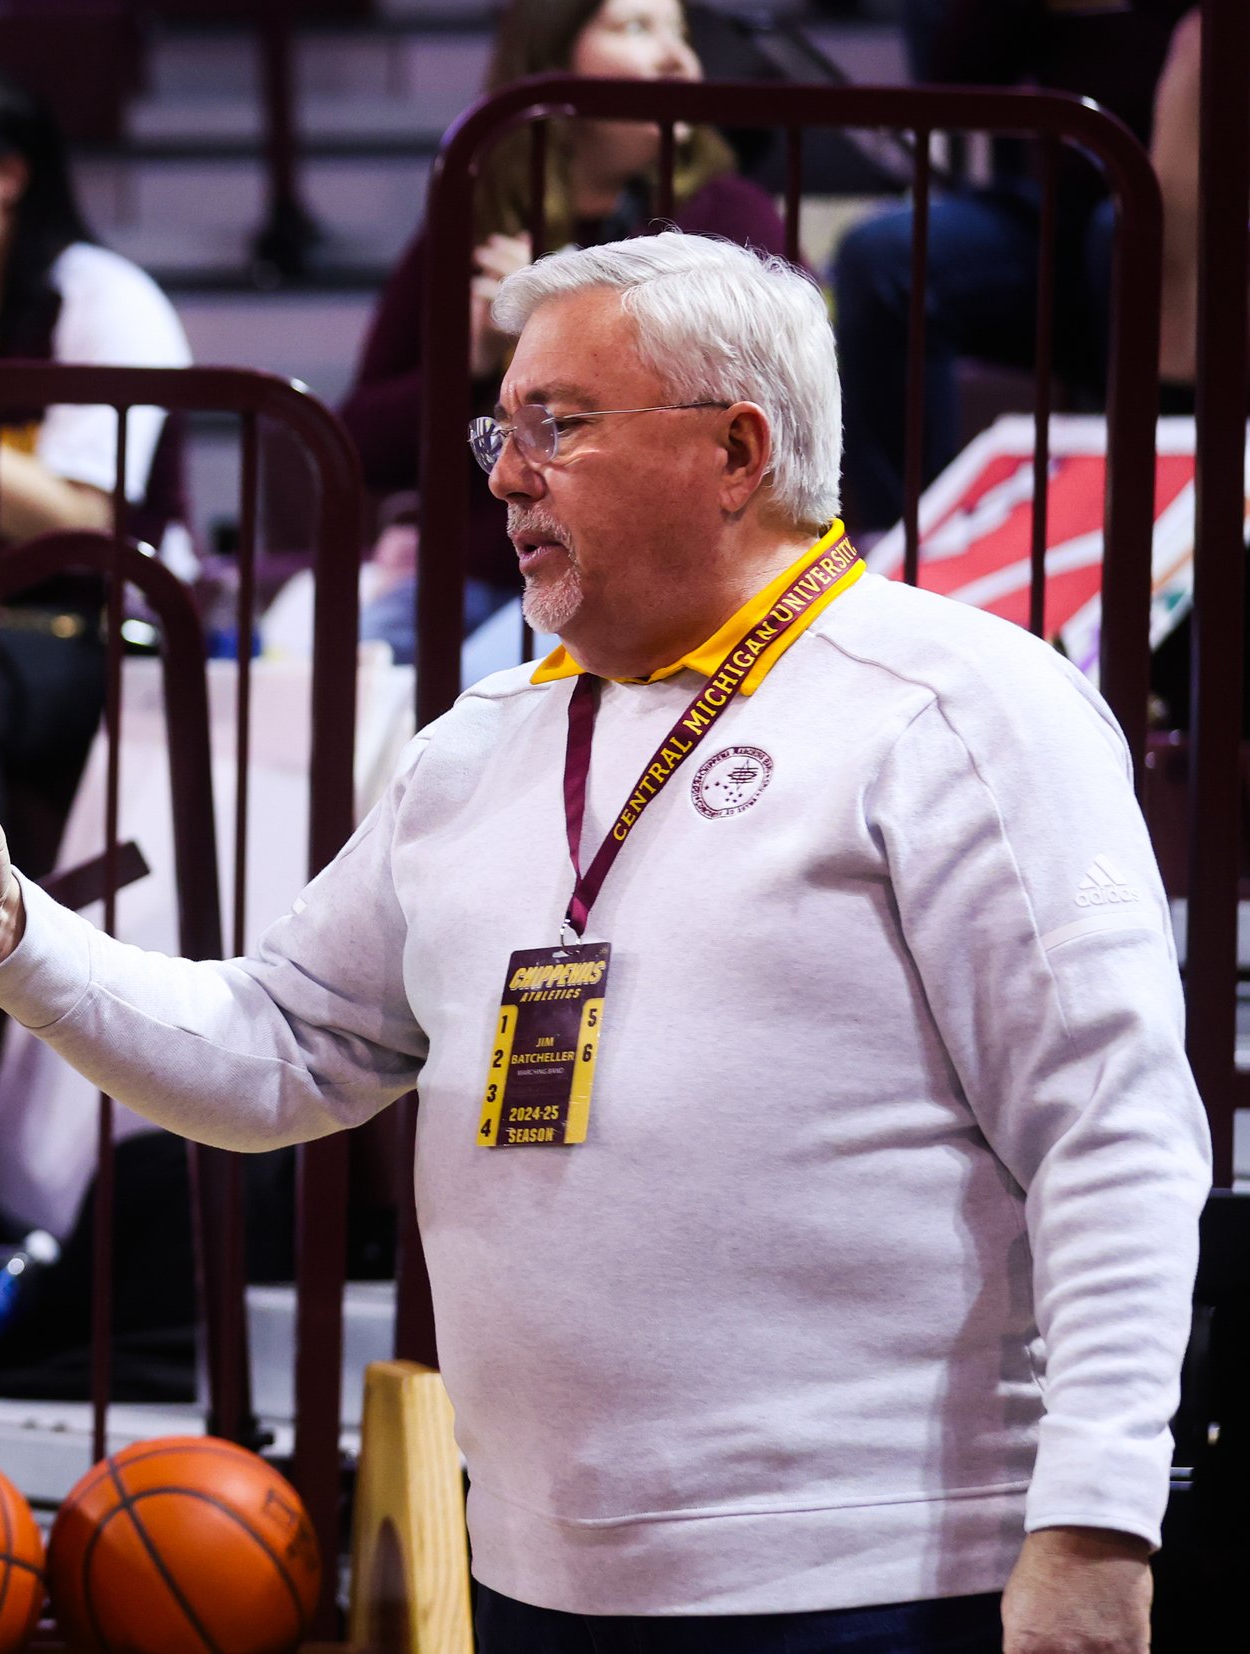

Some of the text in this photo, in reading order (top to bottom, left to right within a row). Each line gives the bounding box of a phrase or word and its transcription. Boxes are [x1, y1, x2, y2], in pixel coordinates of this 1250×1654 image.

[613, 736, 693, 842] CENTRAL
[683, 621, 778, 736] MICHIGAN
[1074, 884, 1140, 908] adidas
[509, 961, 606, 991] CHIPPEWAS
[519, 988, 582, 1003] ATHLETICS
[501, 1014, 508, 1034] 1
[588, 1008, 597, 1027] 5
[535, 1037, 555, 1048] JIM
[492, 1049, 504, 1068] 2
[511, 1051, 575, 1065] BATCHELLER
[582, 1043, 593, 1062] 6
[486, 1084, 498, 1103] 3
[509, 1104, 560, 1122] 2024-25
[480, 1118, 492, 1137] 4
[508, 1127, 554, 1143] SEASON
